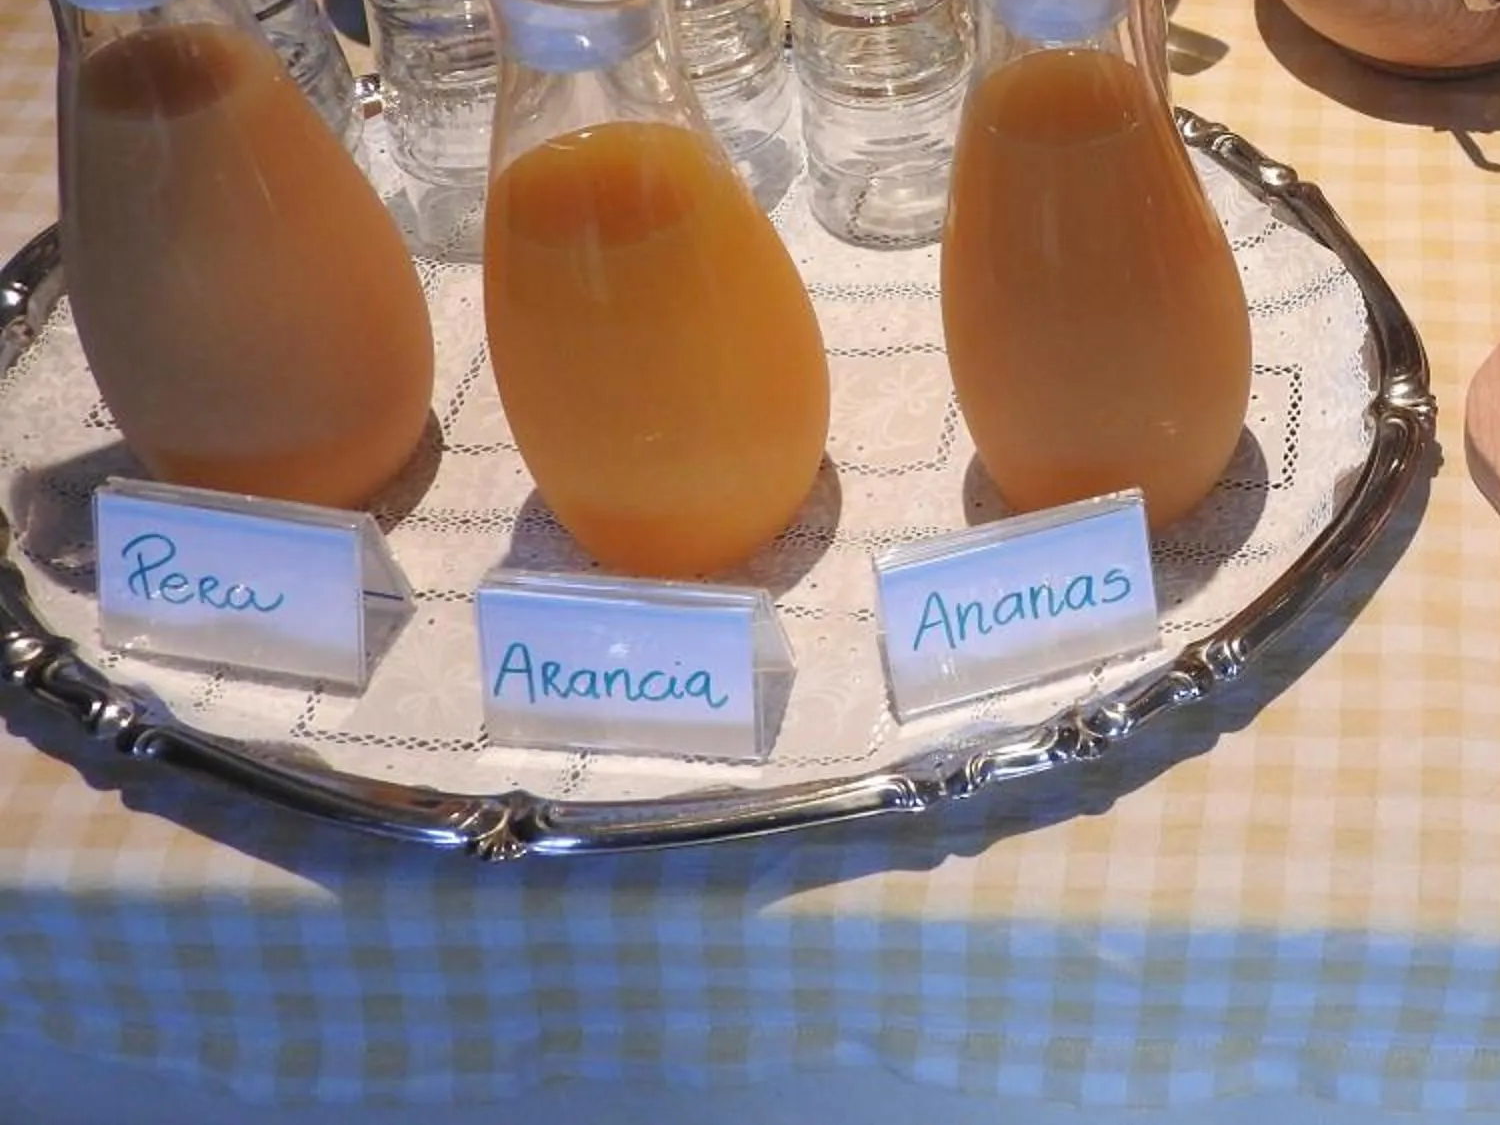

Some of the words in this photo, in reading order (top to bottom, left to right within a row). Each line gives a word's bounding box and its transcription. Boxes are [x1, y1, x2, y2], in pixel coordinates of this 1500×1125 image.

[121, 533, 285, 612] Pera
[912, 567, 1132, 652] Ananas
[493, 641, 730, 709] Arancia
